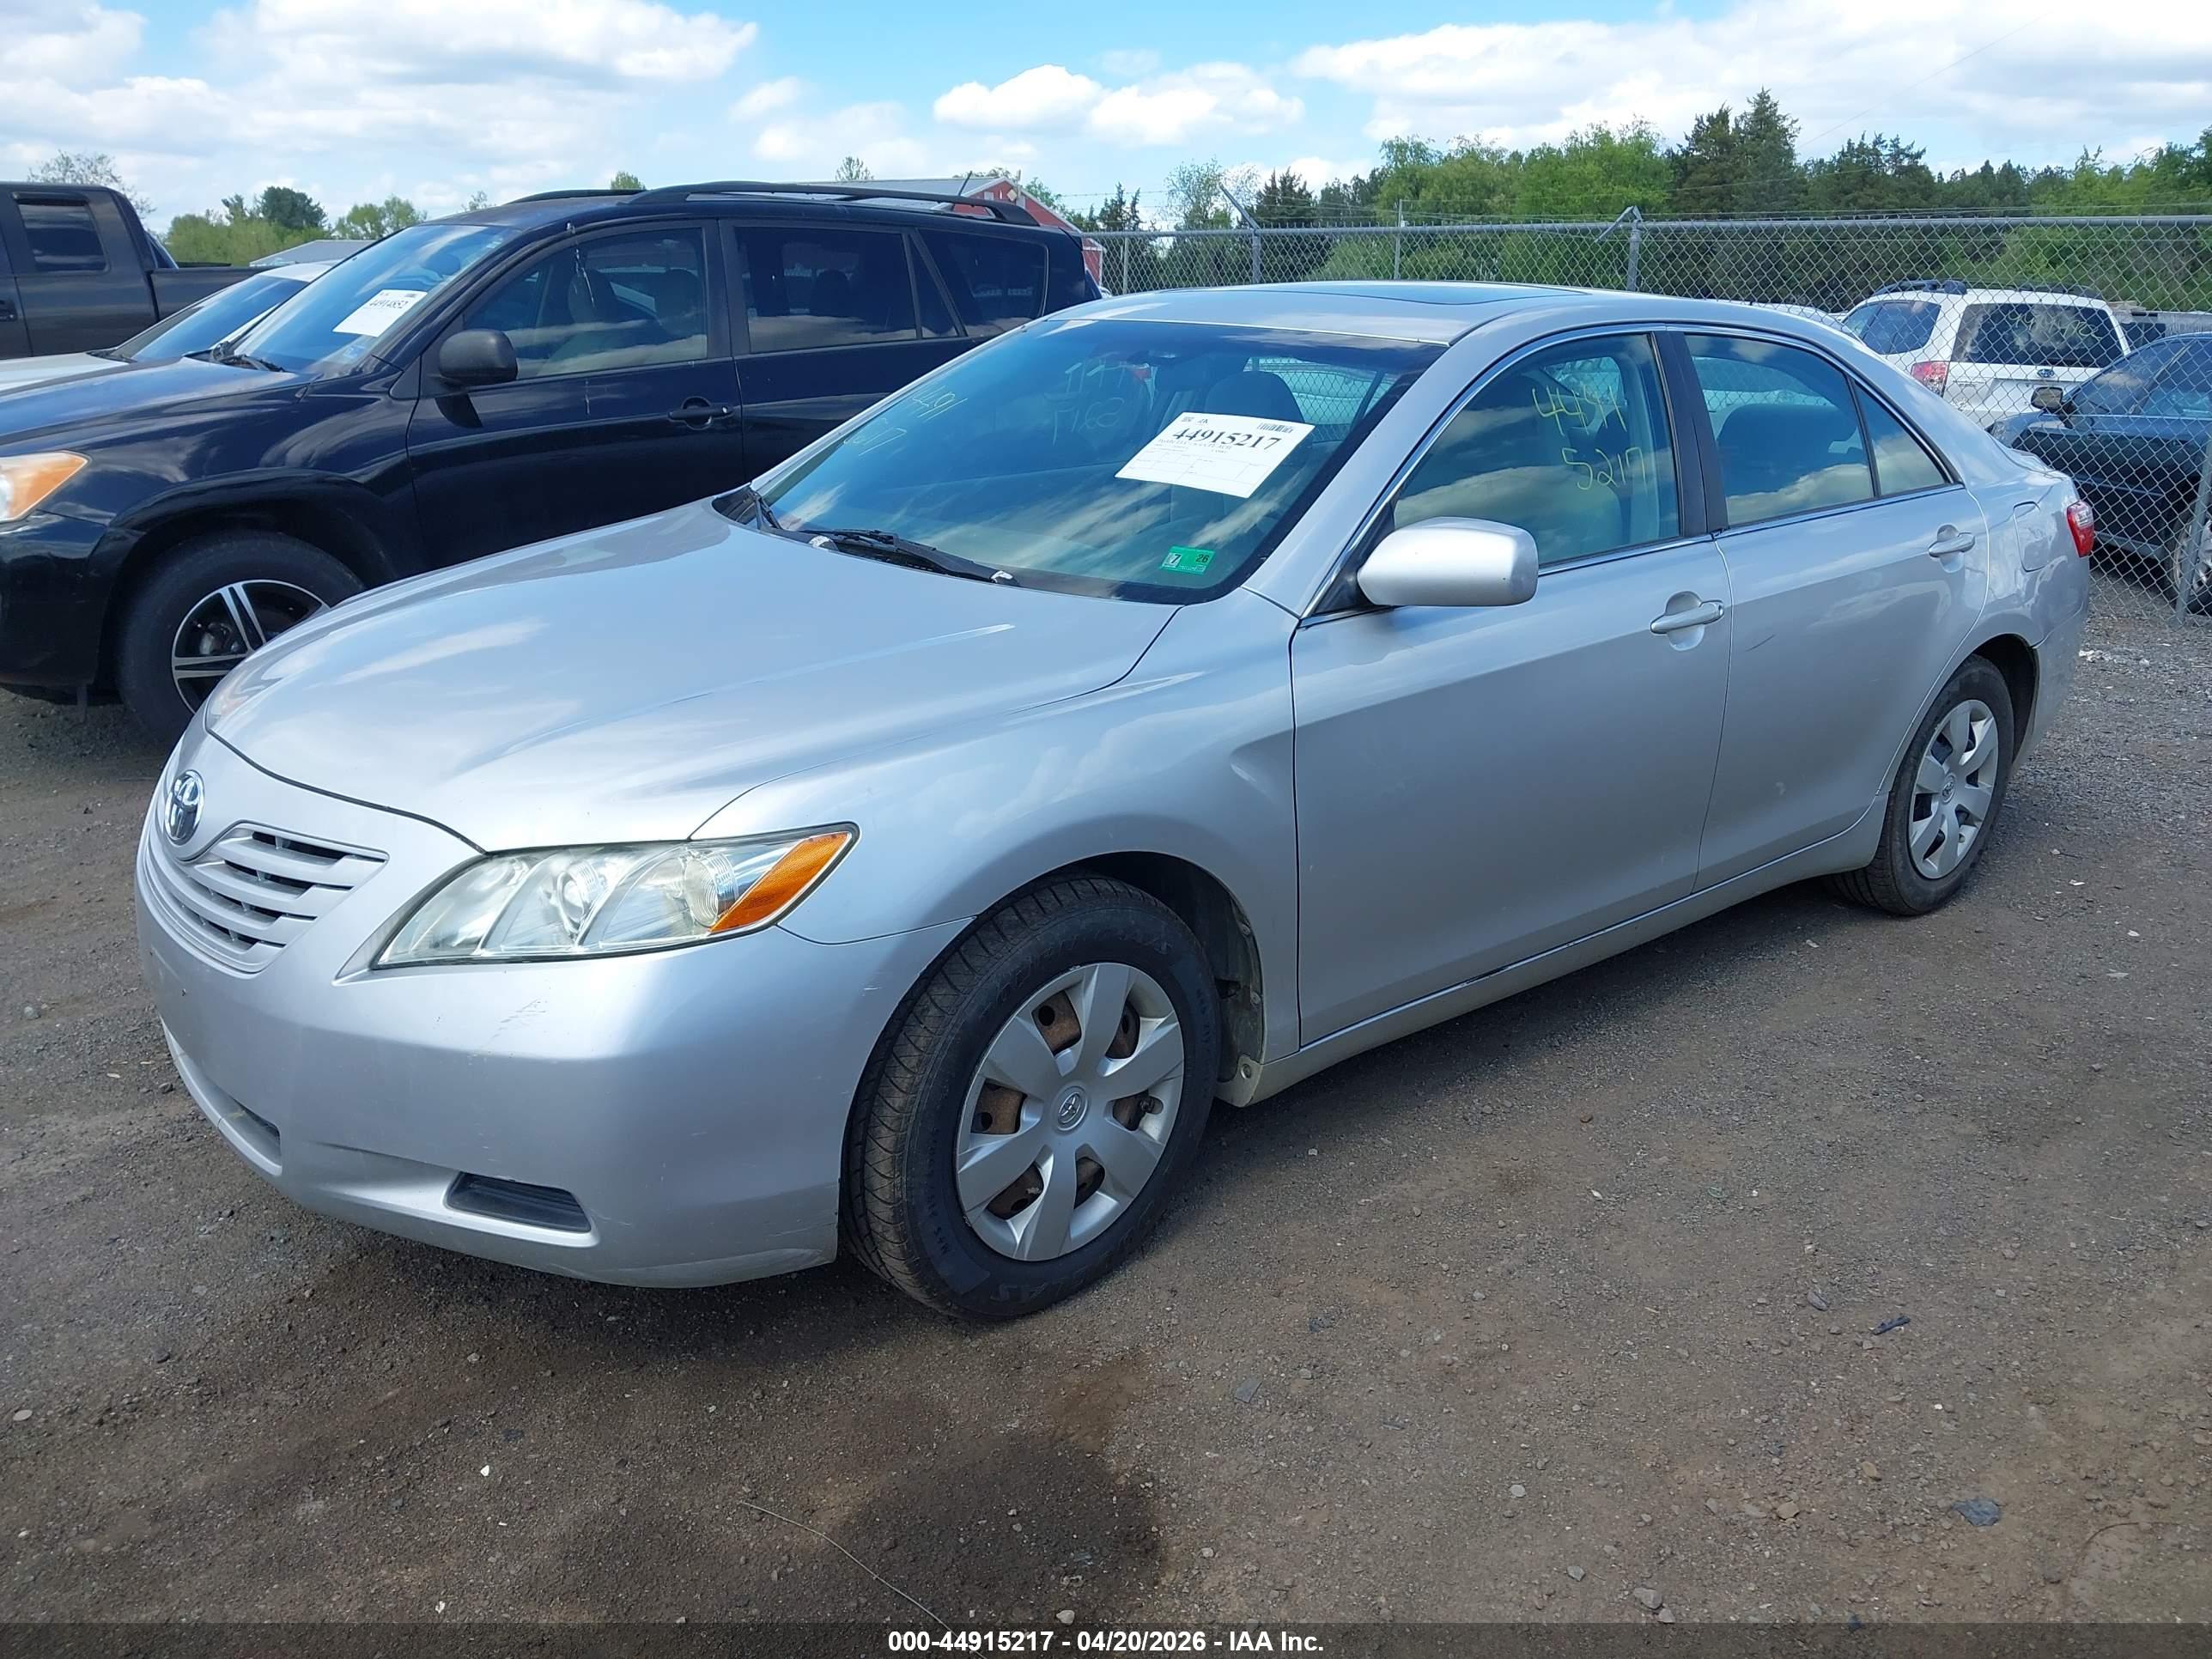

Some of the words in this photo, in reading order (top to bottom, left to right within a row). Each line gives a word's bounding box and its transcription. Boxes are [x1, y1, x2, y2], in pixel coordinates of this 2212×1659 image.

[1172, 428, 1282, 450] 44915217
[1561, 446, 1648, 492] 5217
[1170, 553, 1182, 564] 7
[1194, 553, 1210, 563] 26
